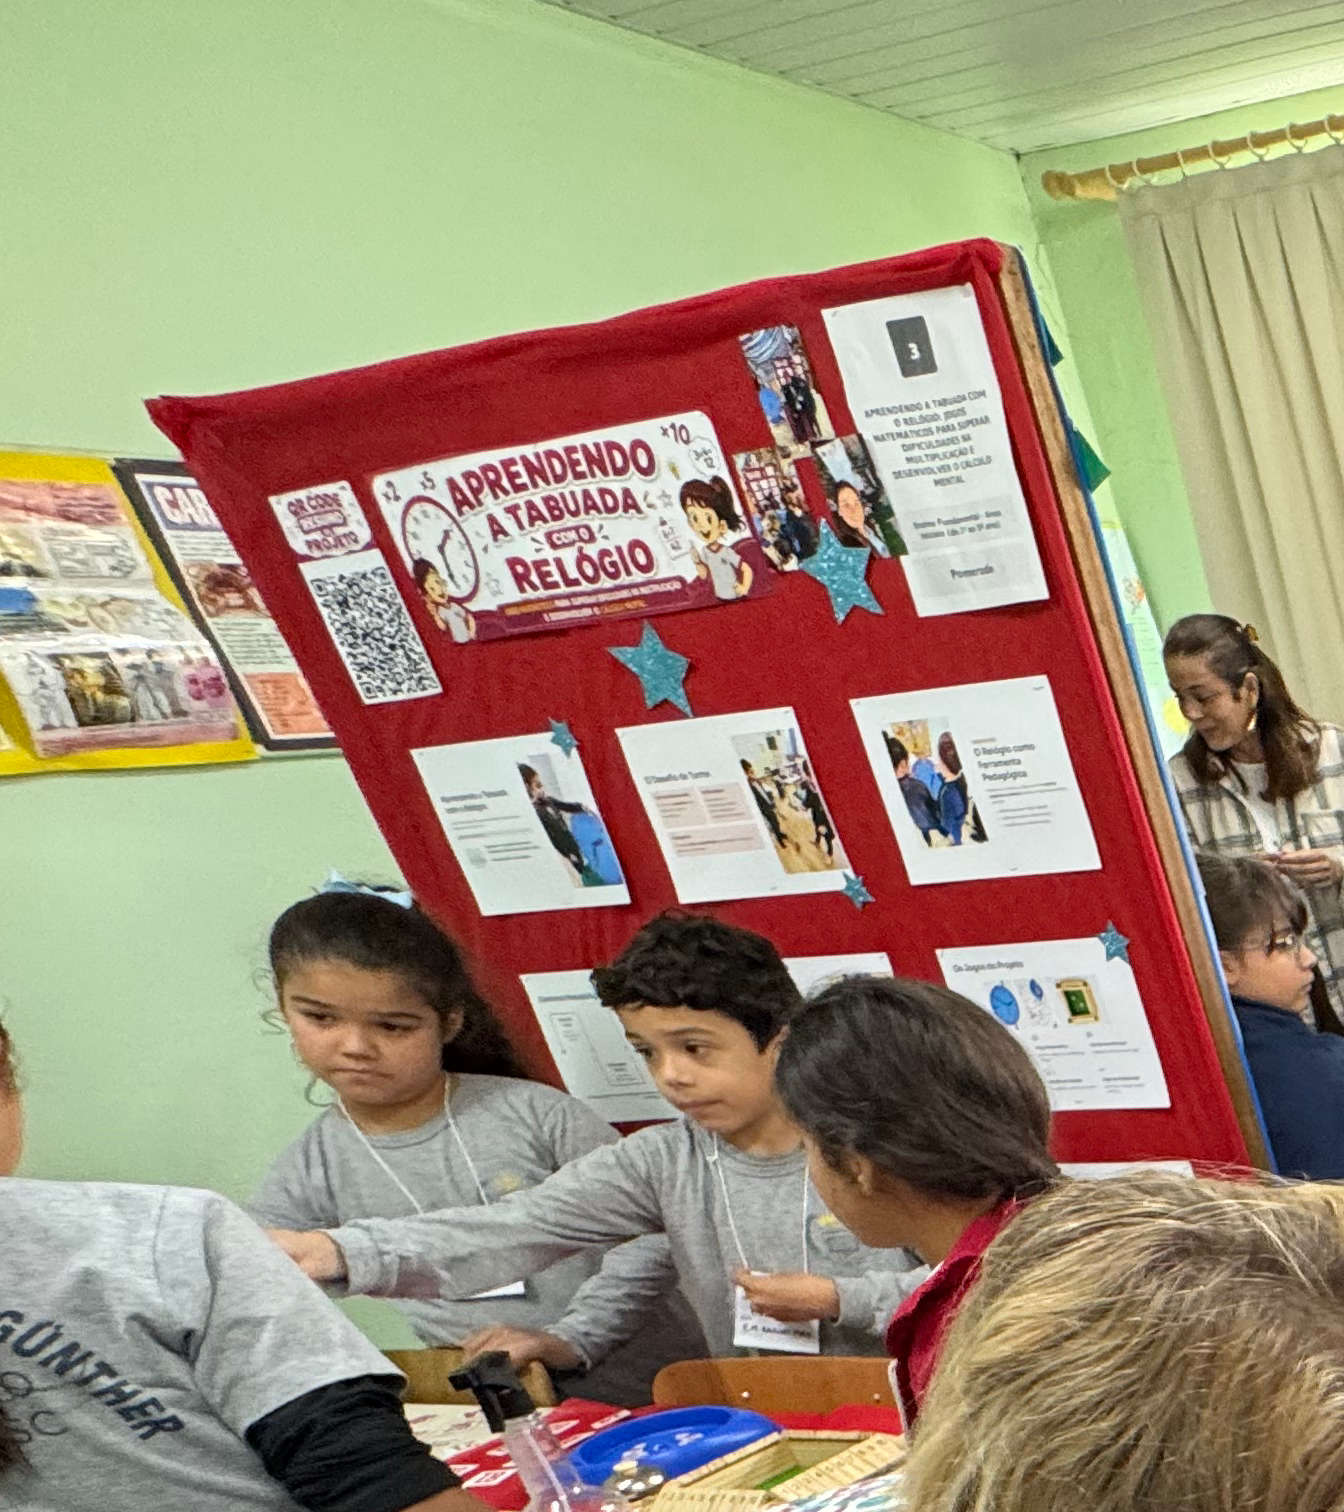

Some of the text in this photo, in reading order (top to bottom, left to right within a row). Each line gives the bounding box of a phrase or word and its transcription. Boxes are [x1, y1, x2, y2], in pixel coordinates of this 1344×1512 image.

[908, 342, 921, 360] 3
[446, 438, 657, 518] APRENDENDO
[486, 487, 643, 543] A TABUADA
[505, 538, 656, 595] RELÓGIO
